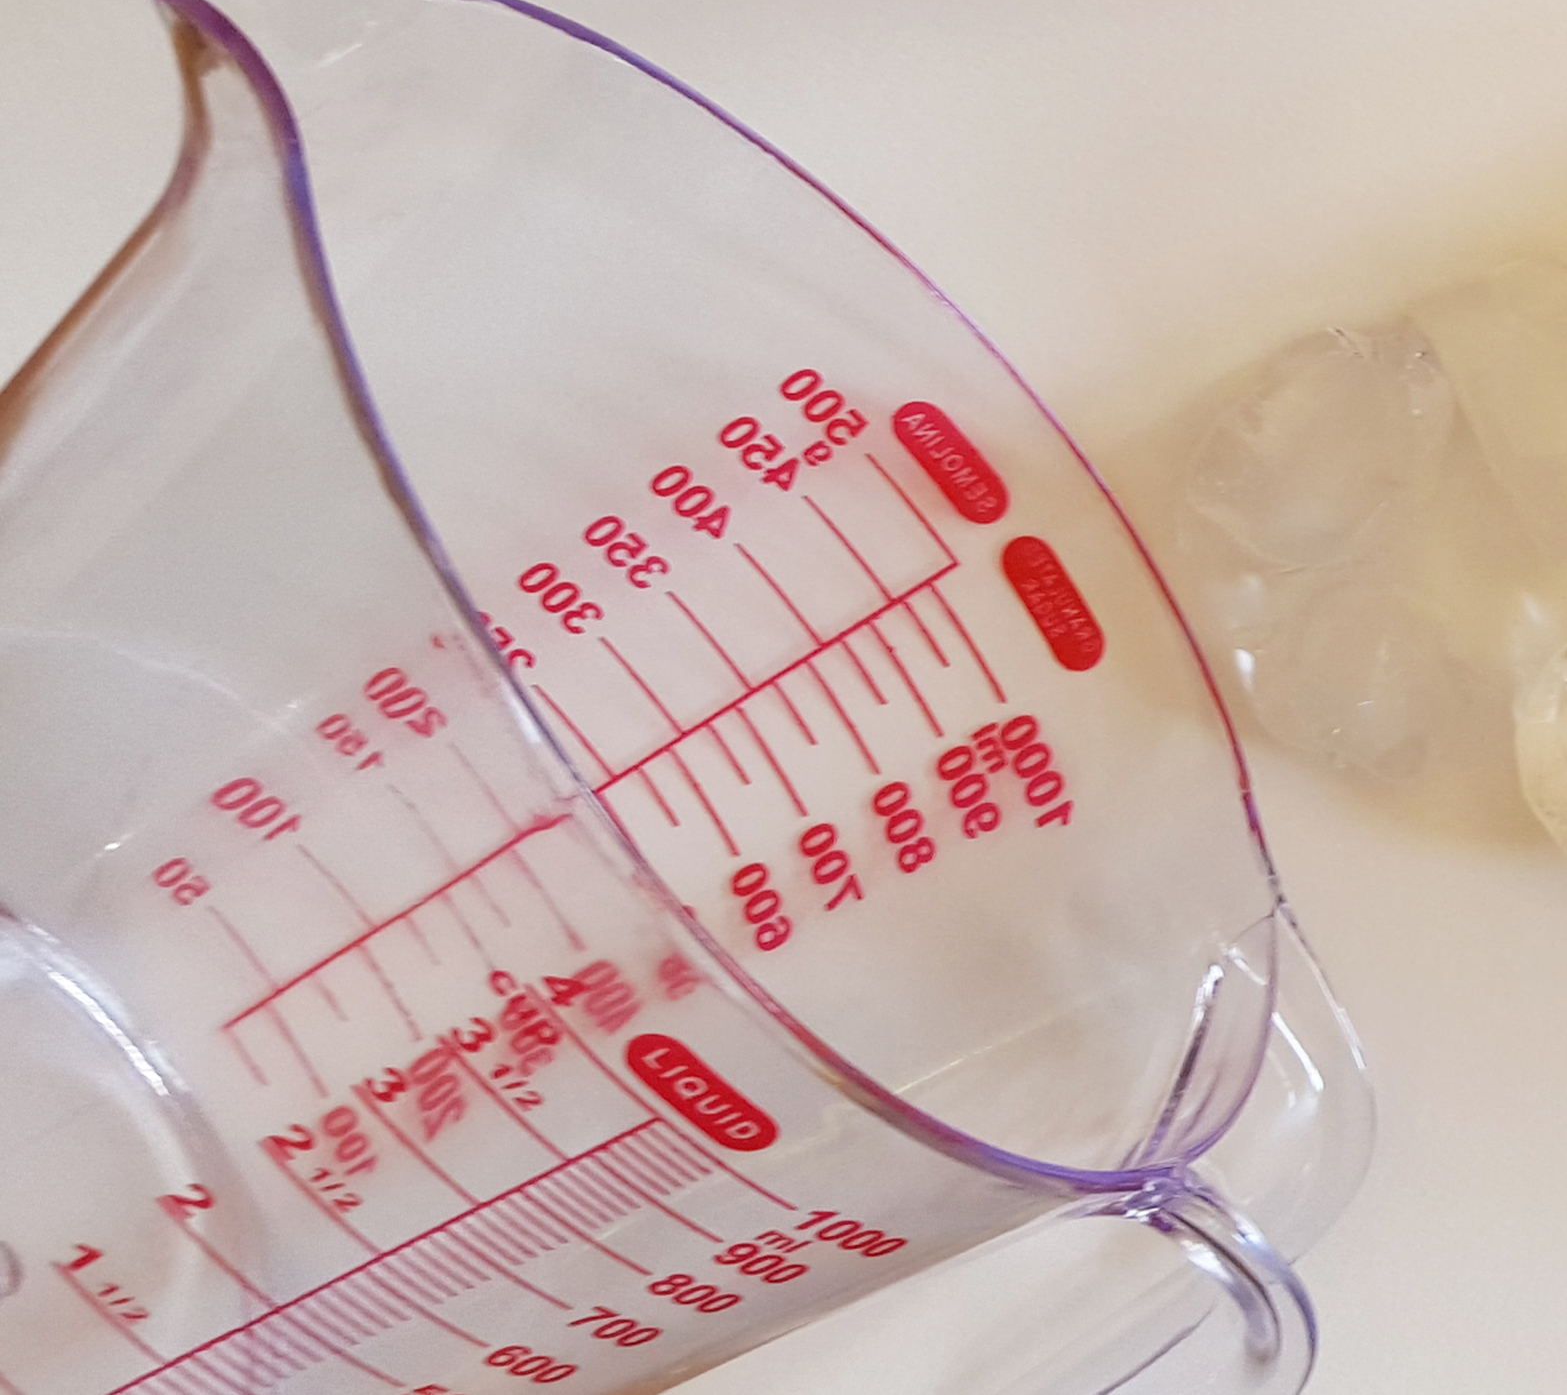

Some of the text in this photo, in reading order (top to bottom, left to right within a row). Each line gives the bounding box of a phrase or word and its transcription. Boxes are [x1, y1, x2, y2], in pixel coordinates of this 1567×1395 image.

[541, 973, 584, 1009] 4
[450, 1015, 497, 1055] 3
[361, 1064, 407, 1103] 3
[641, 1047, 761, 1142] LIQUID
[266, 1120, 316, 1162] 2
[162, 1182, 214, 1215] 2
[757, 1230, 813, 1254] ml
[795, 1210, 908, 1258] 1000
[62, 1243, 104, 1273] 1
[713, 1242, 810, 1284] 900
[647, 1273, 743, 1314] 800
[566, 1305, 665, 1349] 700
[483, 1344, 581, 1386] 600
